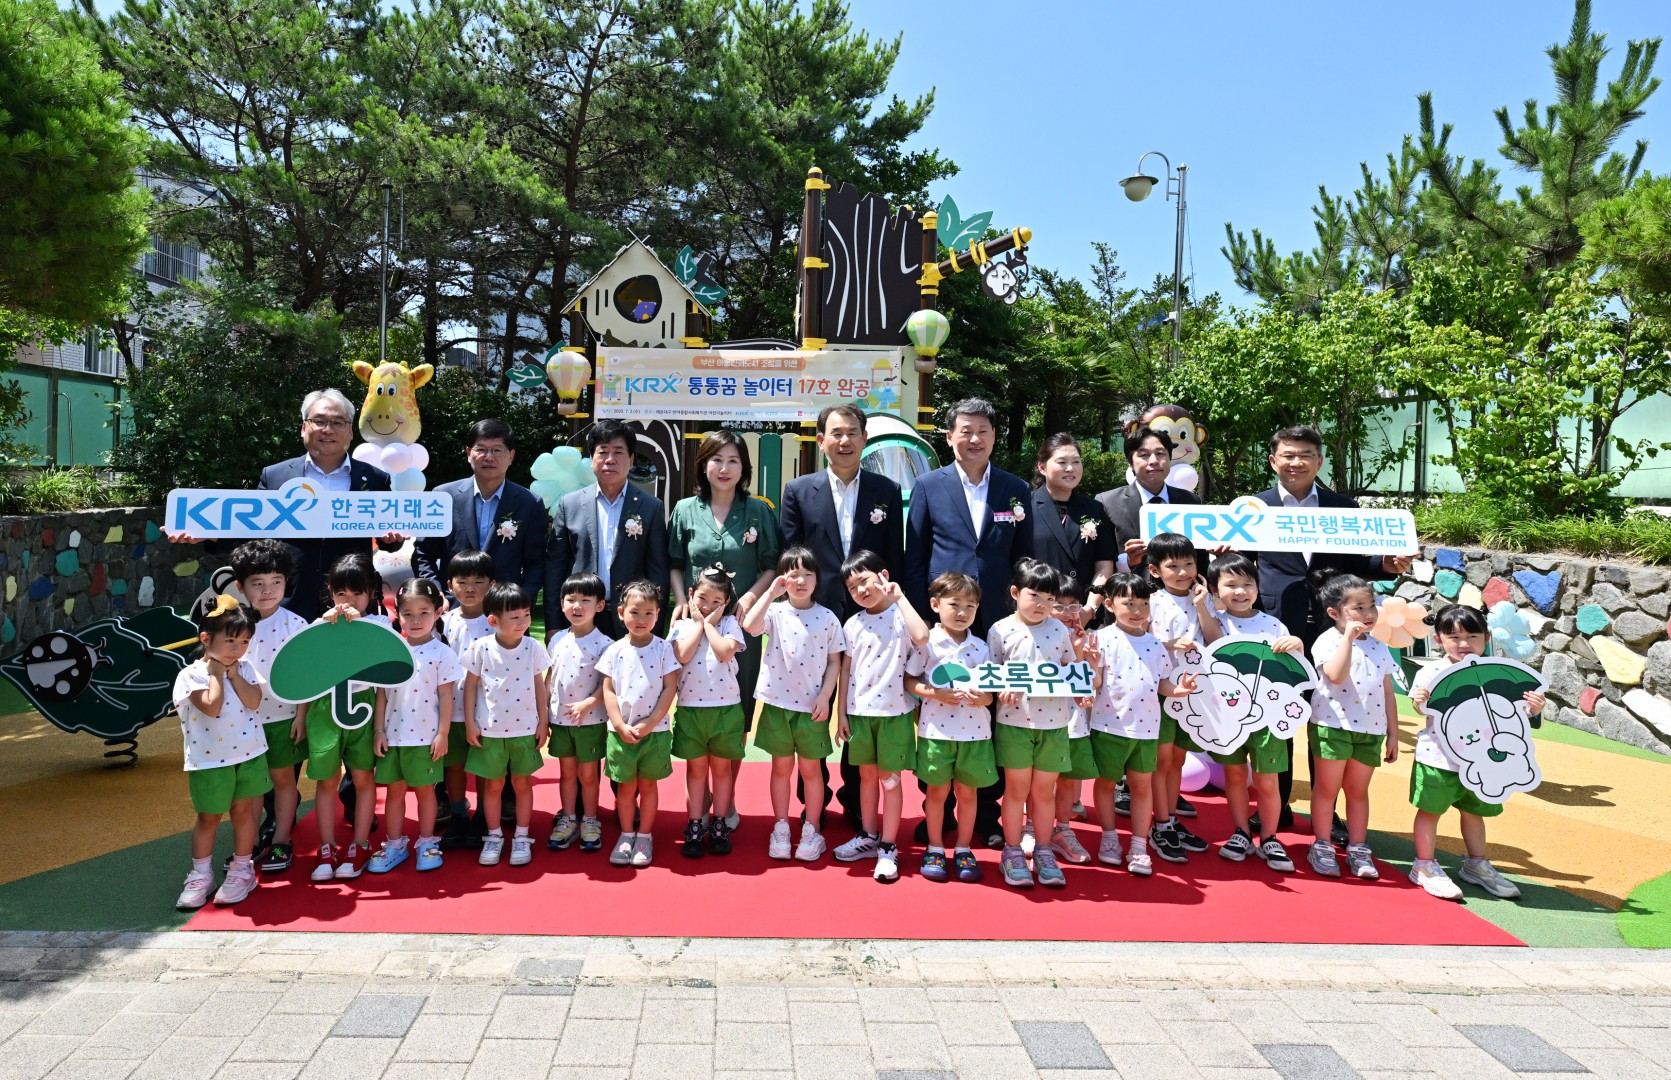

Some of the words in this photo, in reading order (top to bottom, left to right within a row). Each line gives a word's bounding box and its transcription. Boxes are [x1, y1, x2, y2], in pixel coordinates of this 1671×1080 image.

[700, 359, 715, 367] 부산
[625, 376, 682, 394] KRX
[687, 376, 737, 396] 통통꿈
[743, 377, 793, 397] 놀이터
[798, 378, 832, 397] 17호
[837, 378, 870, 398] 완공
[175, 497, 318, 531] KRX
[331, 497, 444, 519] 한국거래소
[332, 522, 374, 530] KOREA
[378, 522, 444, 530] EXCHANGE
[1148, 512, 1264, 542] KRX
[1275, 514, 1406, 536] 국민행복재단
[1278, 536, 1320, 544] HAPPY
[1326, 538, 1407, 548] FOUNDATION
[978, 662, 1094, 694] 초록우산
